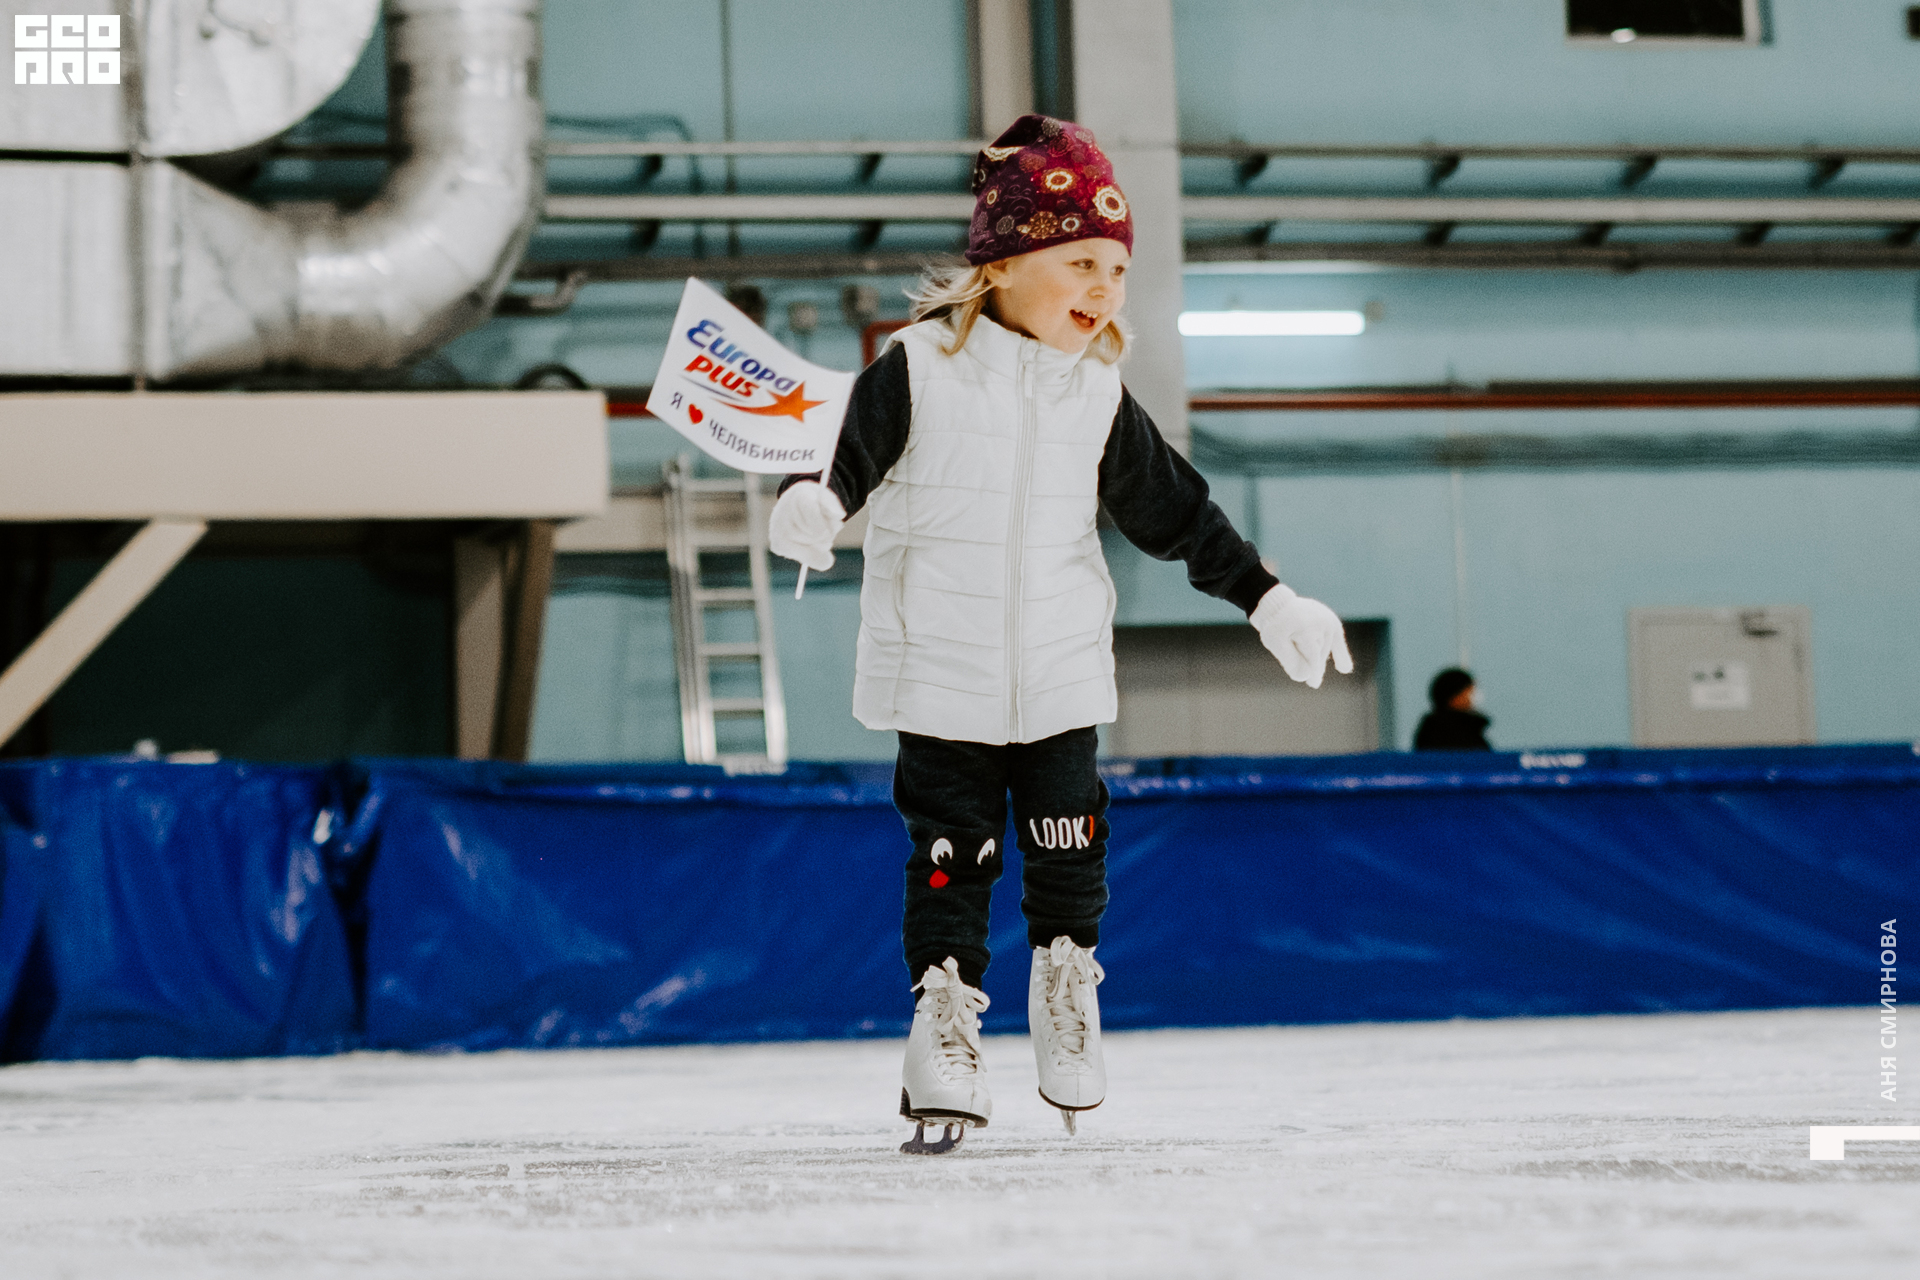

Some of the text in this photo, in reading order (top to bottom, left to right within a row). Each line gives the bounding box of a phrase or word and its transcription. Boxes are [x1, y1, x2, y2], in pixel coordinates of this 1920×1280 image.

[686, 319, 798, 392] Europa
[670, 391, 816, 462] Я ЧЕЛЯБИНСК
